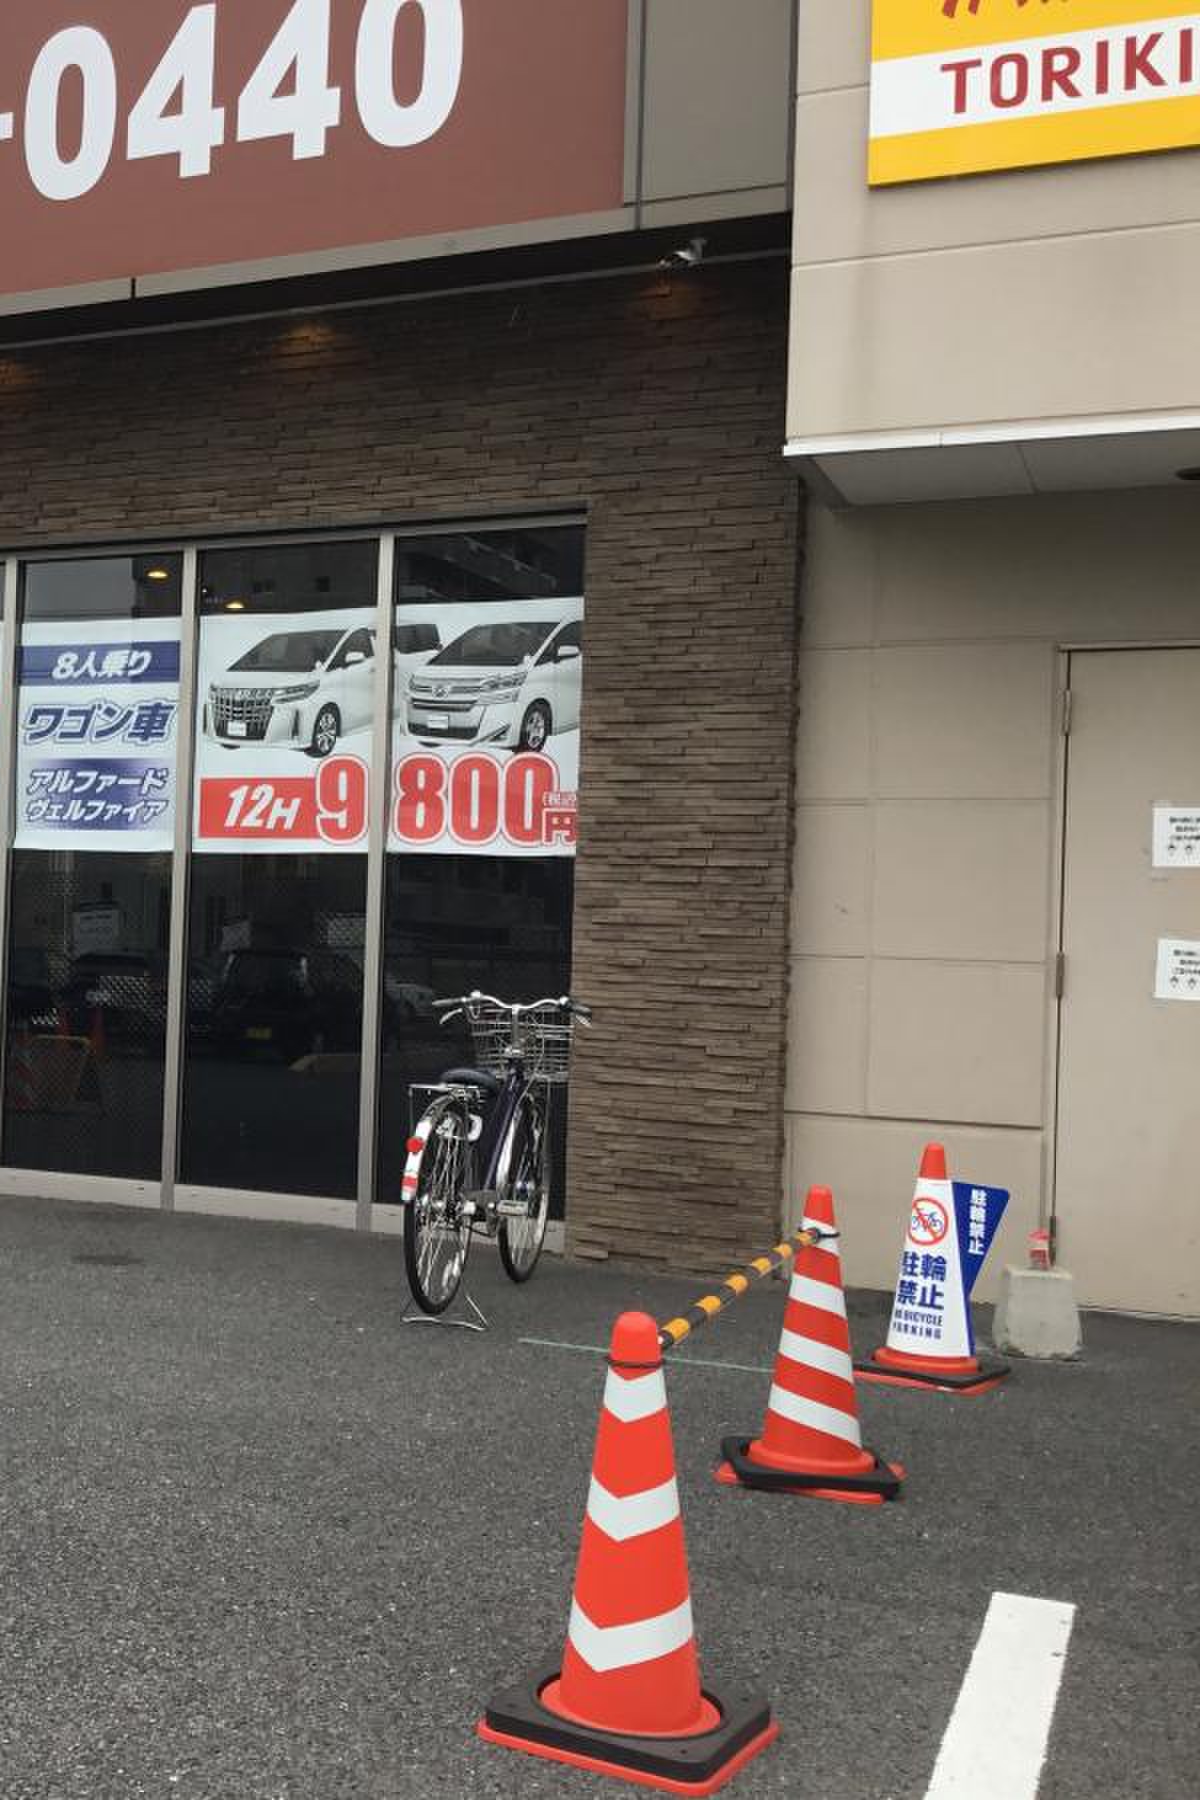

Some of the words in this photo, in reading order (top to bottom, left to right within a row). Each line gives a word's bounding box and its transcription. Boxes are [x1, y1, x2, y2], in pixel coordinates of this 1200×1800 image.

[940, 28, 1193, 114] TORIKI
[51, 650, 152, 680] 8人乗り
[25, 700, 177, 743] ワゴン車
